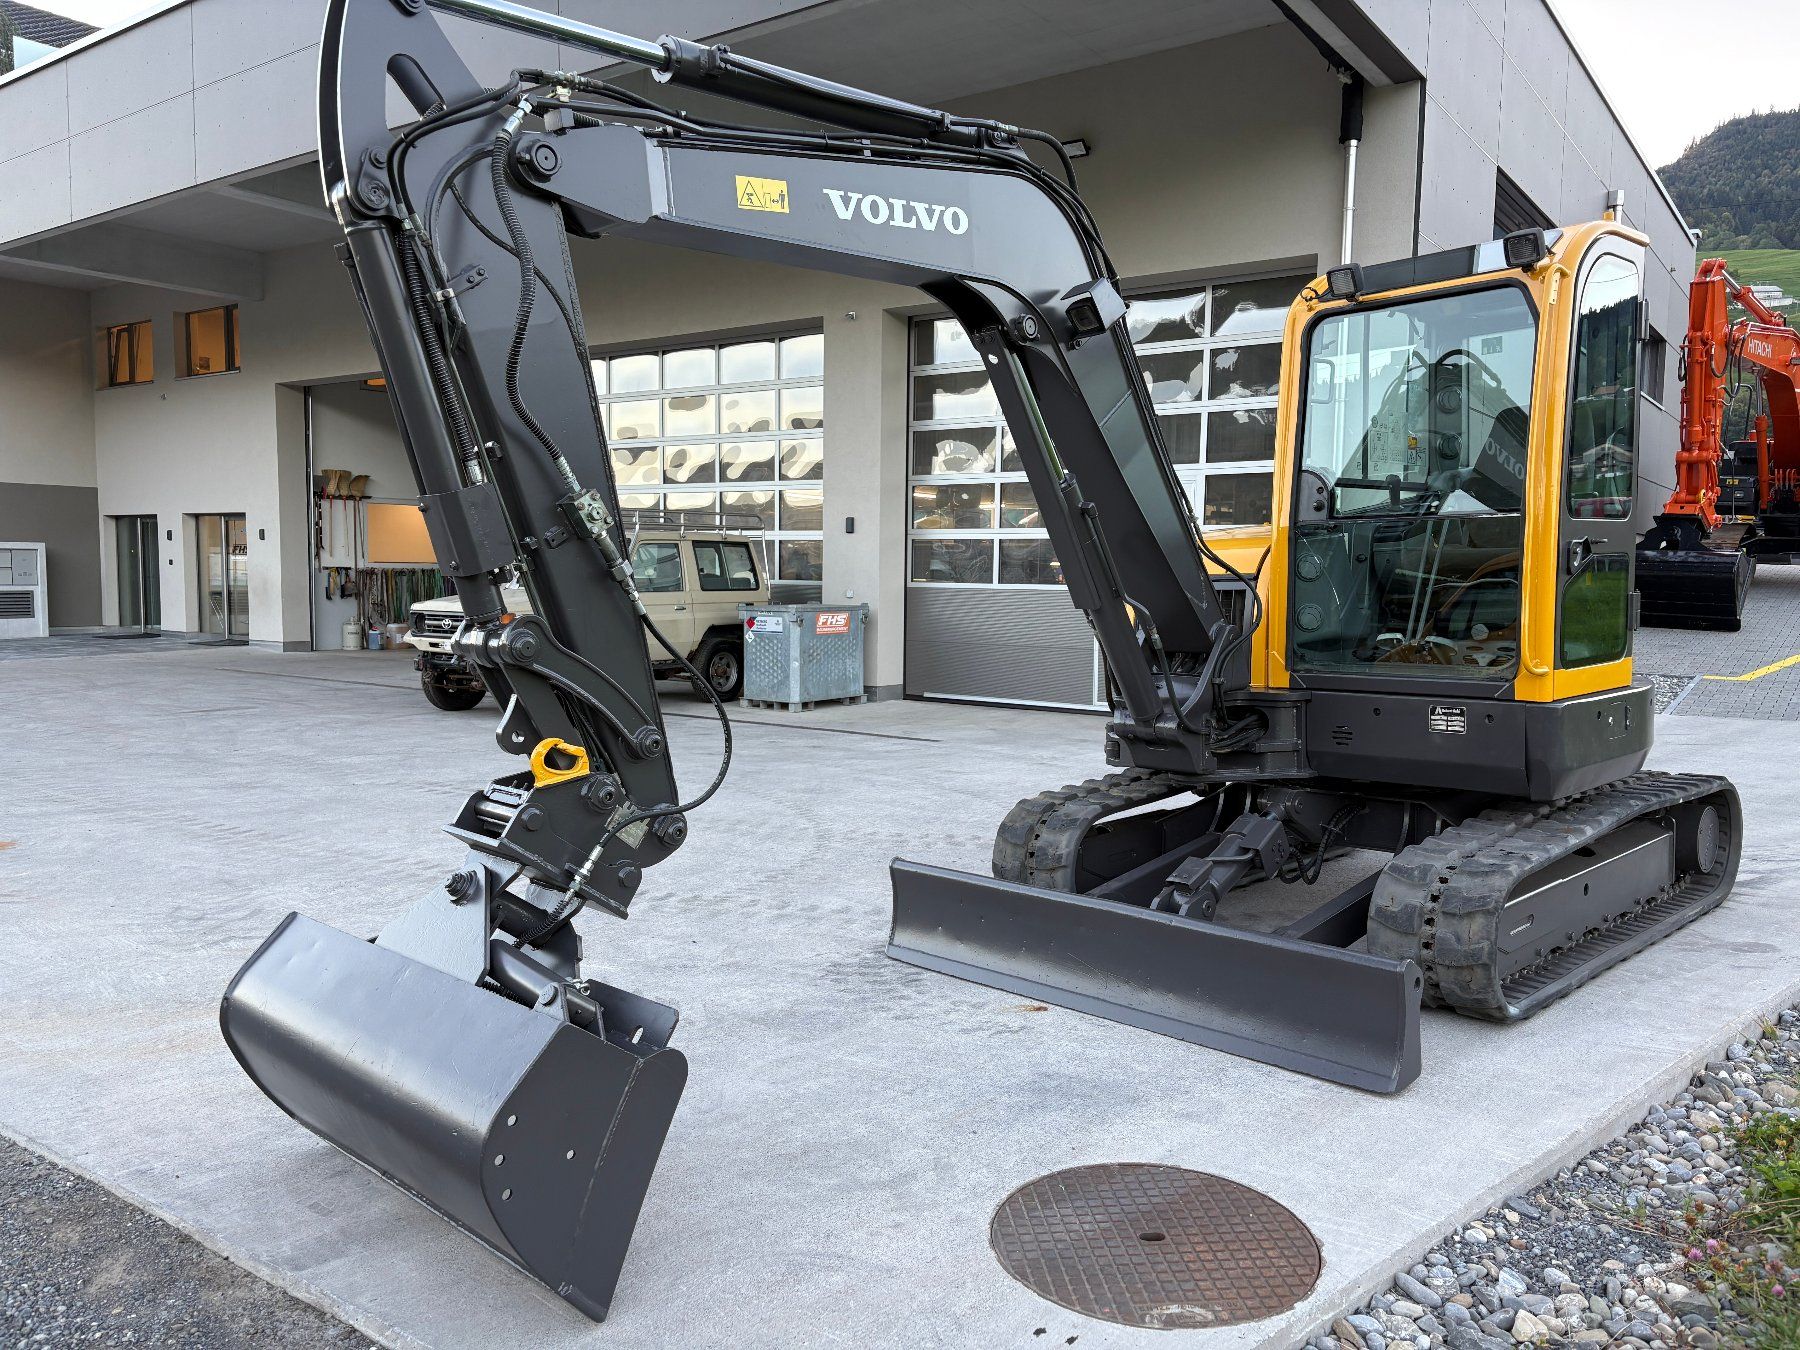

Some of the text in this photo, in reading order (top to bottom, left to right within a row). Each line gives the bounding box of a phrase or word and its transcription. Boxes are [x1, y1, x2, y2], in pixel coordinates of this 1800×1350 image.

[822, 188, 969, 235] VOLVO
[1748, 338, 1772, 358] HITACHI
[232, 545, 247, 554] FH
[818, 615, 847, 625] FHS
